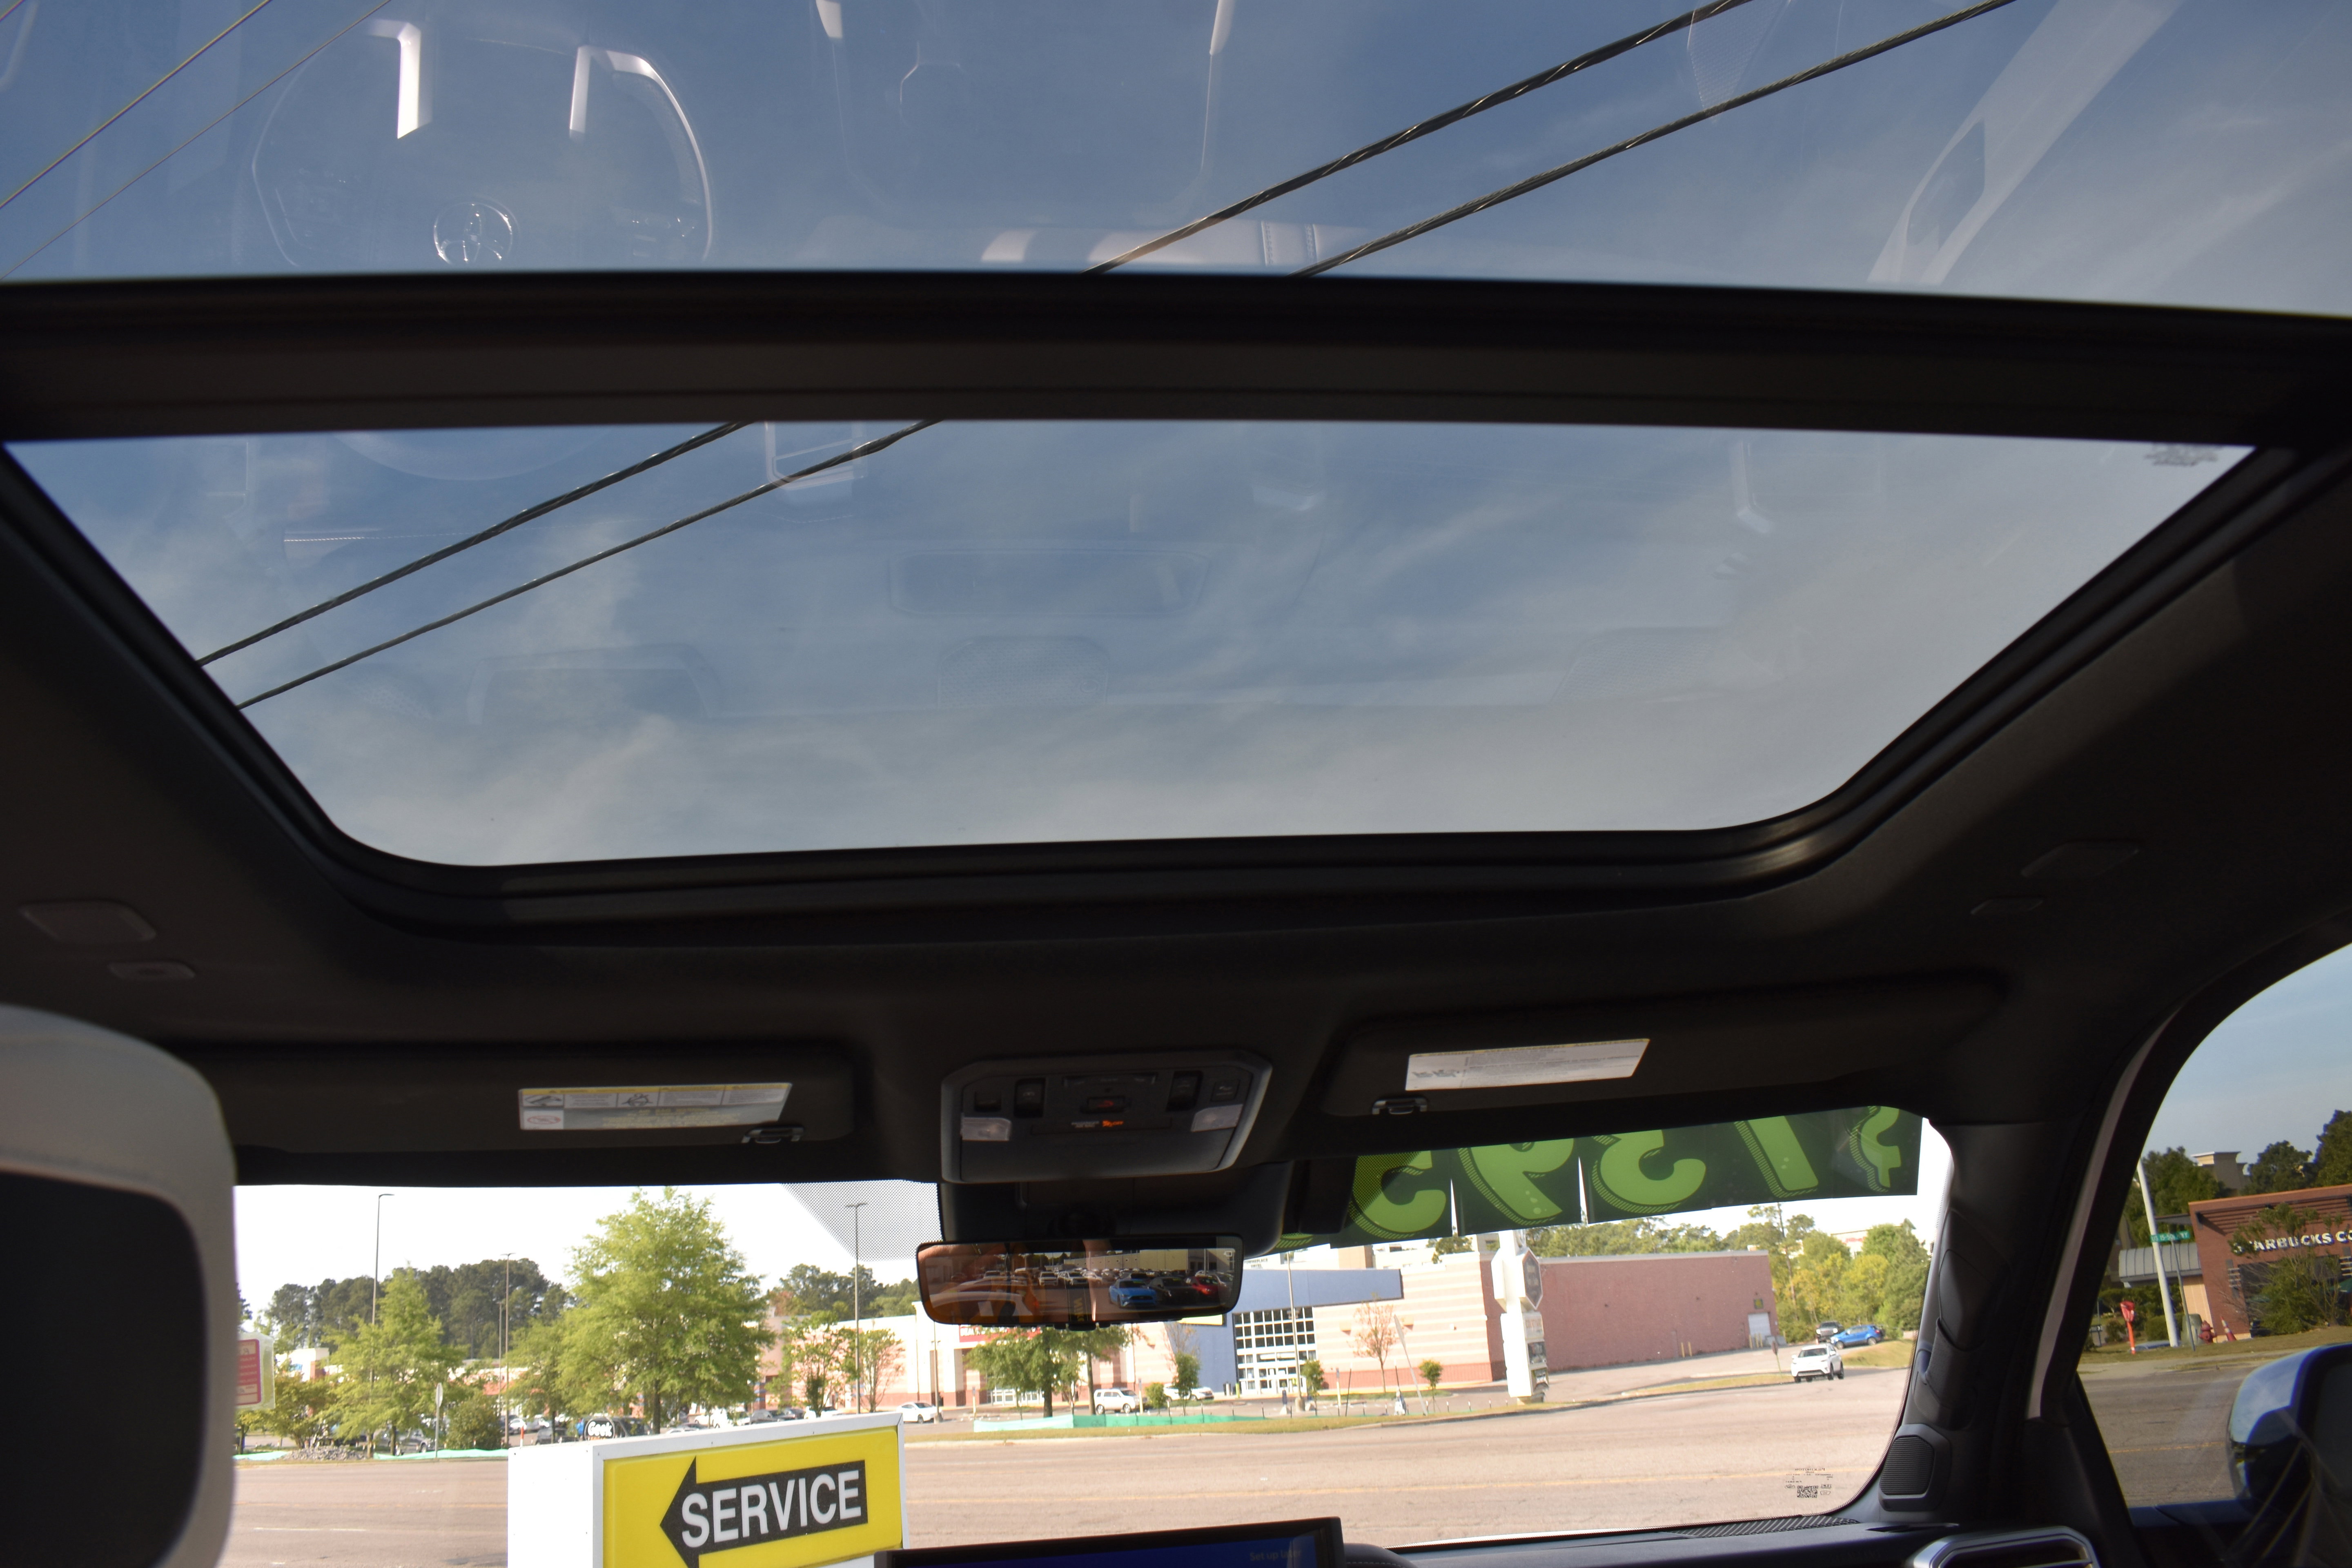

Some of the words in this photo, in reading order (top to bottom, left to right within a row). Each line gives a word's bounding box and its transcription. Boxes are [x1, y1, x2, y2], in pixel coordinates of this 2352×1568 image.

[2233, 1233, 2333, 1254] SARBUCKS
[588, 1421, 612, 1437] Geek
[681, 1470, 862, 1548] SERVICE
[1250, 1552, 1265, 1561] Set
[1266, 1552, 1278, 1561] up
[1281, 1550, 1301, 1559] later
